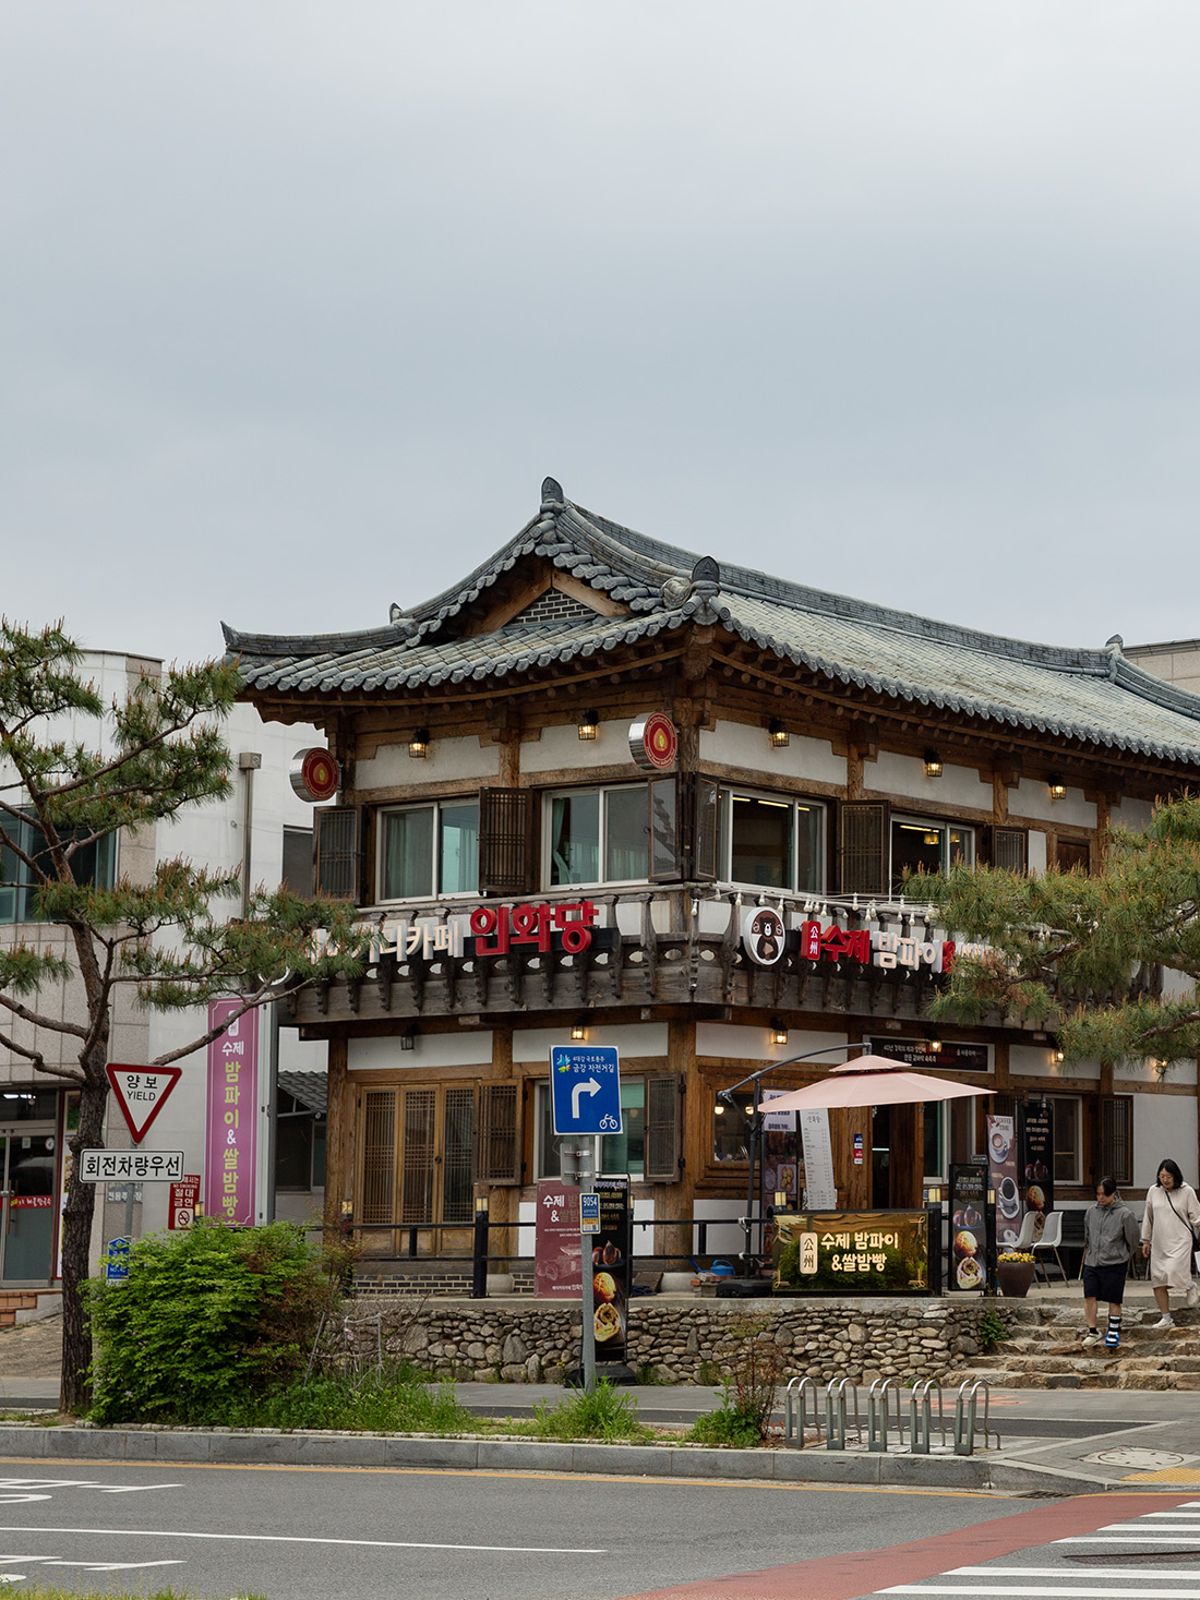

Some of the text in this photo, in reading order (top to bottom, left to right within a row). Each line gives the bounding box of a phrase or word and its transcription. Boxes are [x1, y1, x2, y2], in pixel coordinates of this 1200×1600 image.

[469, 901, 600, 956] 인화당
[820, 924, 870, 964] 수제
[872, 930, 944, 974] 밤파이
[222, 1041, 244, 1056] 수제
[573, 1063, 587, 1073] 금강
[126, 1074, 158, 1089] 양보
[126, 1090, 156, 1102] YIELD
[224, 1061, 241, 1129] 밤파이
[85, 1155, 181, 1178] 회전차량우선
[107, 1190, 143, 1202] 전용주장
[174, 1198, 193, 1207] 금연
[543, 1194, 565, 1208] 수제
[583, 1196, 597, 1207] 9054
[820, 1231, 899, 1250] 수제 밤파이
